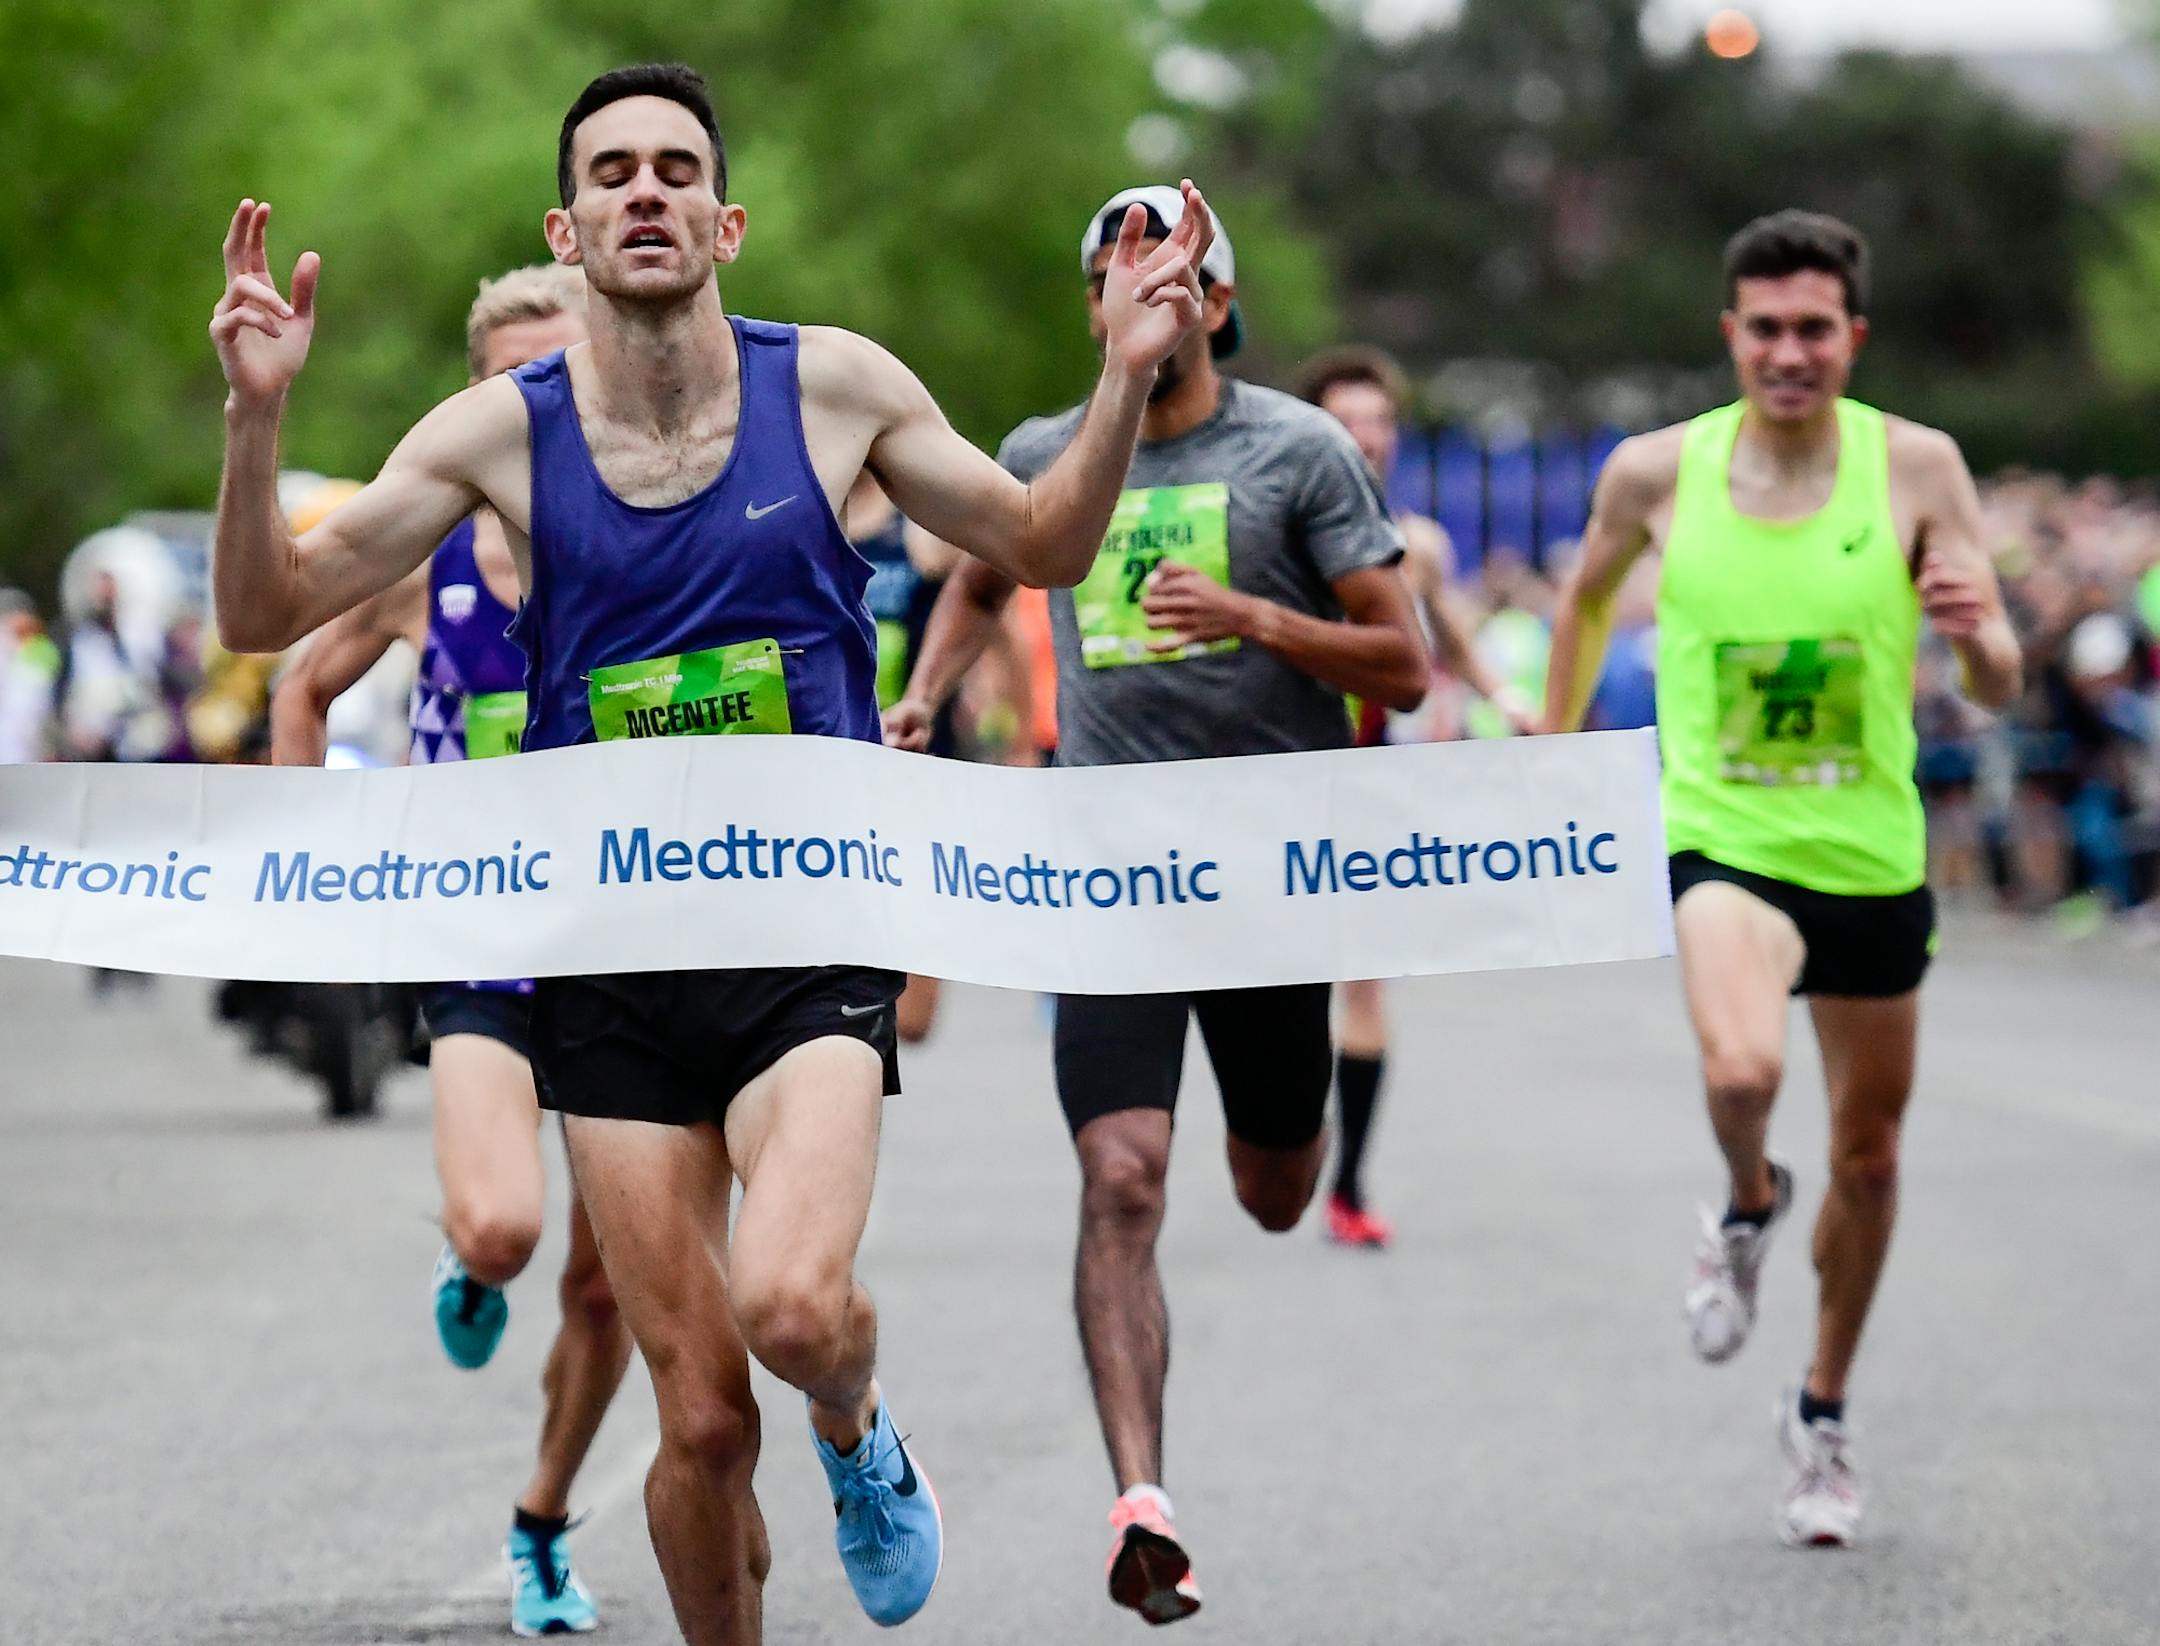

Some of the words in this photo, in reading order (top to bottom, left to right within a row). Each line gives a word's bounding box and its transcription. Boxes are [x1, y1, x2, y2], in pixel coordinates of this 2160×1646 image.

[625, 690, 754, 738] MCENTEE
[254, 840, 550, 902] Medtronic
[598, 824, 903, 887] Medtronic
[931, 841, 1221, 909] Medtronic
[1283, 820, 1618, 897] Medtronic
